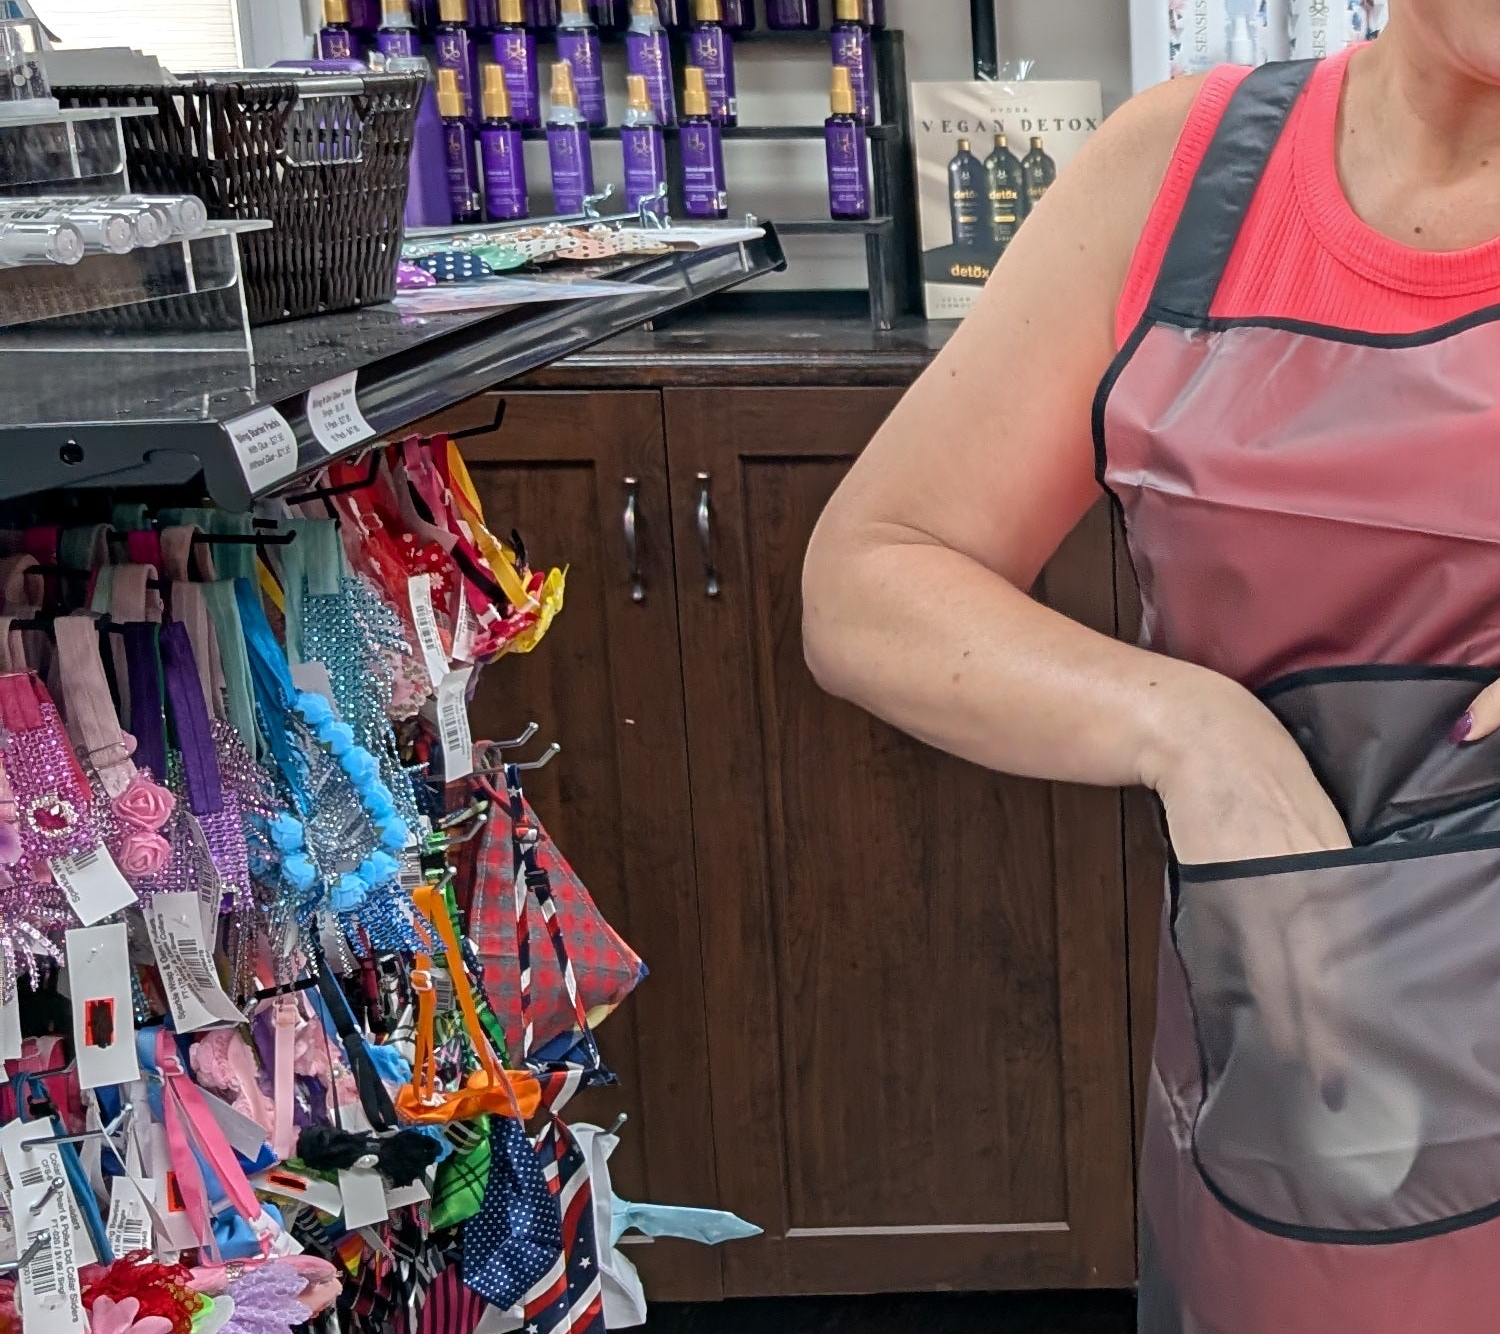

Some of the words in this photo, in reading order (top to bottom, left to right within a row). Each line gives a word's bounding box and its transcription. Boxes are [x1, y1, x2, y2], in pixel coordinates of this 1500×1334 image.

[921, 119, 1005, 134] VEGAN
[1021, 118, 1099, 133] DETOX
[61, 1223, 72, 1248] Polka
[63, 1249, 73, 1265] Dot
[66, 1266, 77, 1291] Collar
[69, 1293, 81, 1323] Sliders
